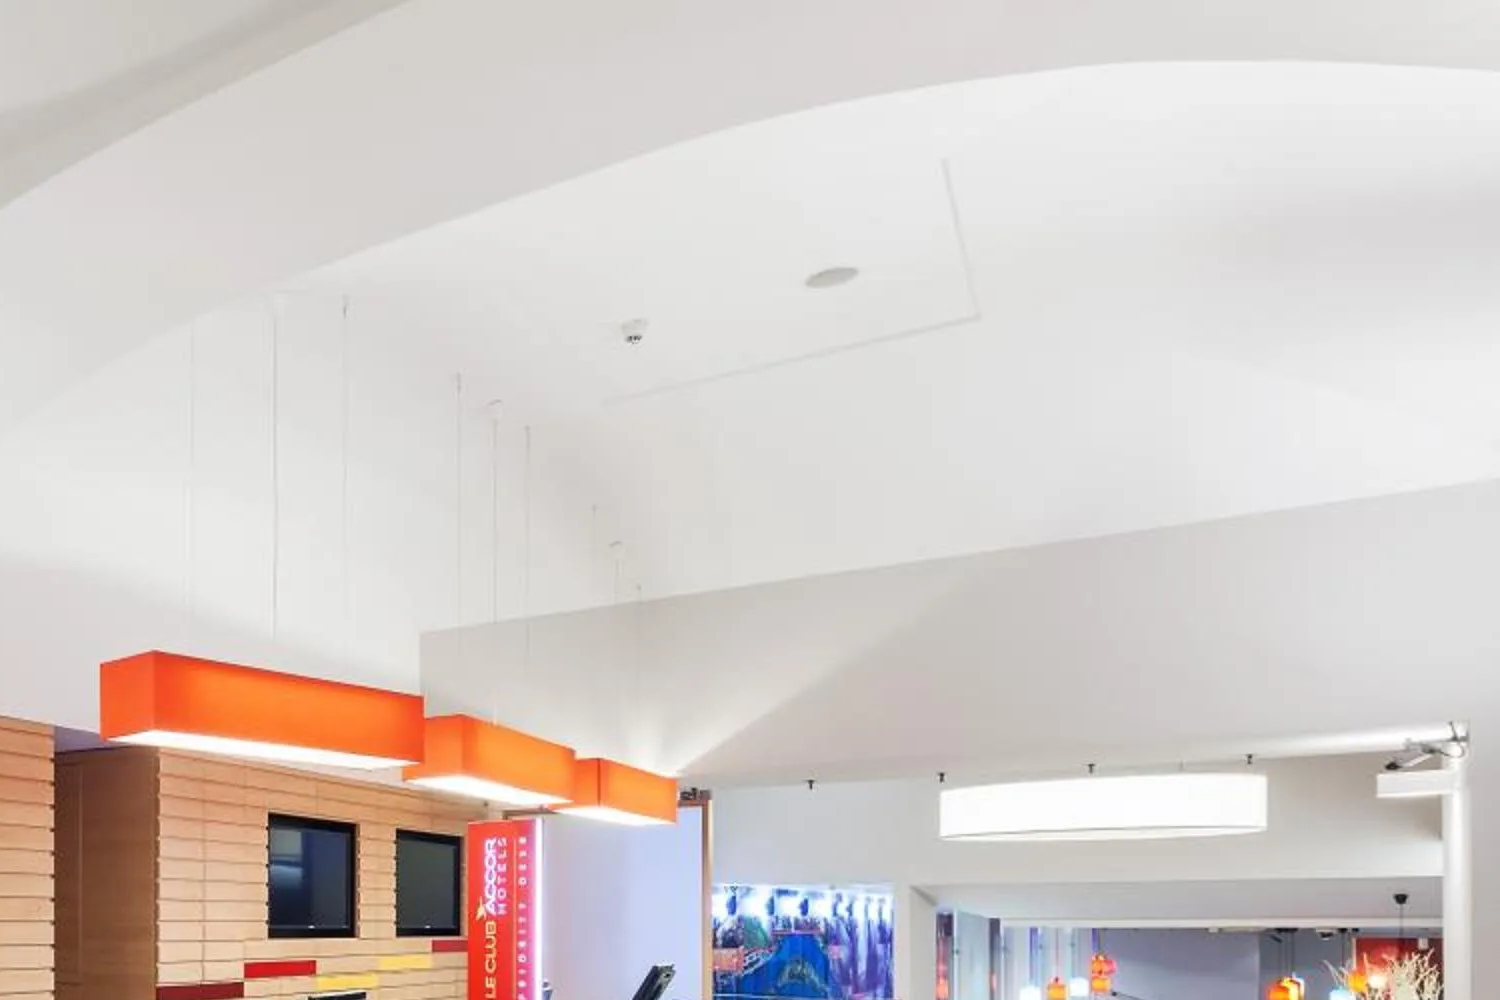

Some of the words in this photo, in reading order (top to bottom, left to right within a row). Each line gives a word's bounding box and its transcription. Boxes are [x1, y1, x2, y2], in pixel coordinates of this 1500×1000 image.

[484, 837, 497, 916] ACCOR
[497, 837, 507, 915] HOTELS
[484, 921, 497, 974] CLUB
[484, 977, 497, 999] LE
